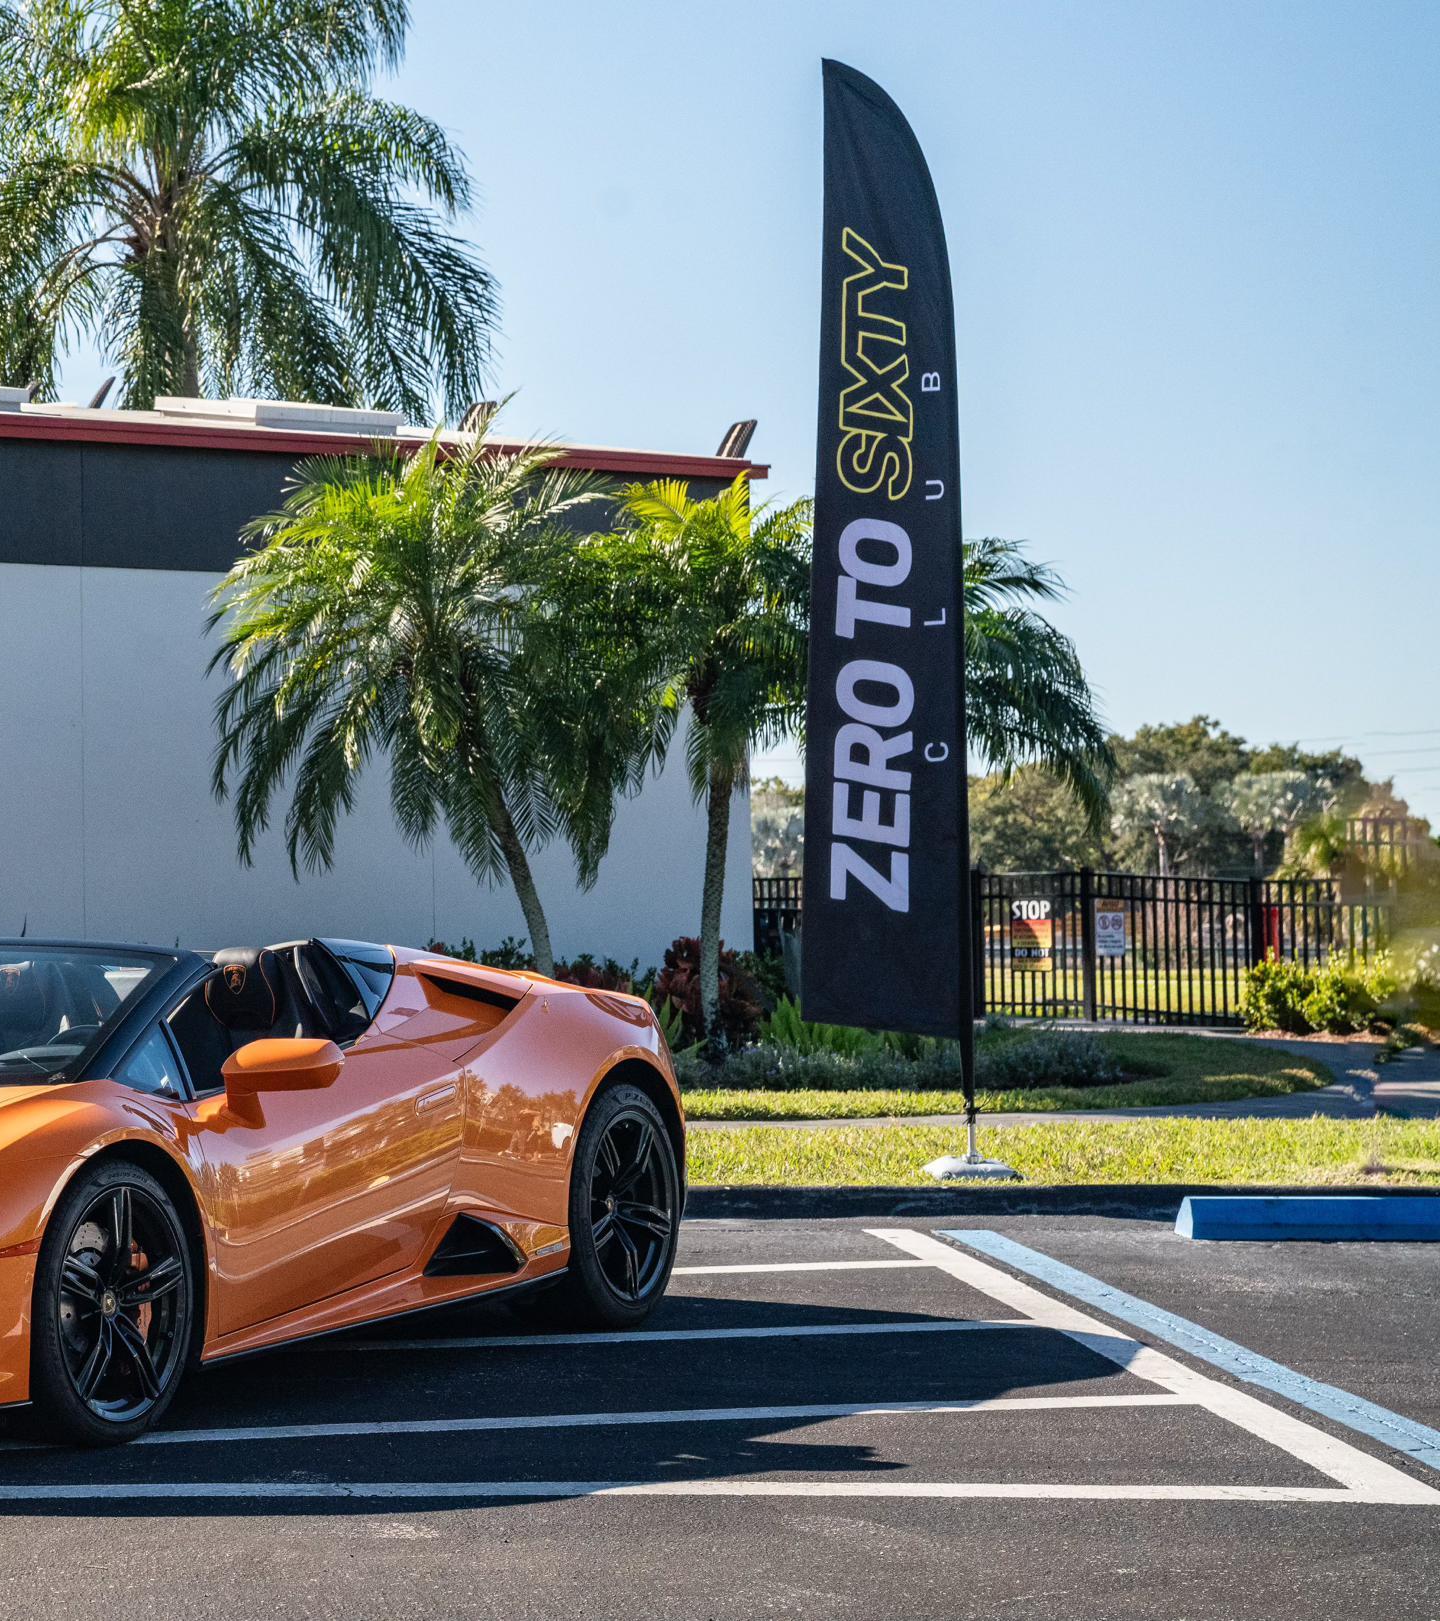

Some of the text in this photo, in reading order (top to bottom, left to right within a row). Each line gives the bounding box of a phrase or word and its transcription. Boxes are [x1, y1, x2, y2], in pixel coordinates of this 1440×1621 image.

[830, 226, 915, 913] ZERO TO SIXTY
[1012, 900, 1051, 919] STOP
[1015, 949, 1049, 957] DO NOT
